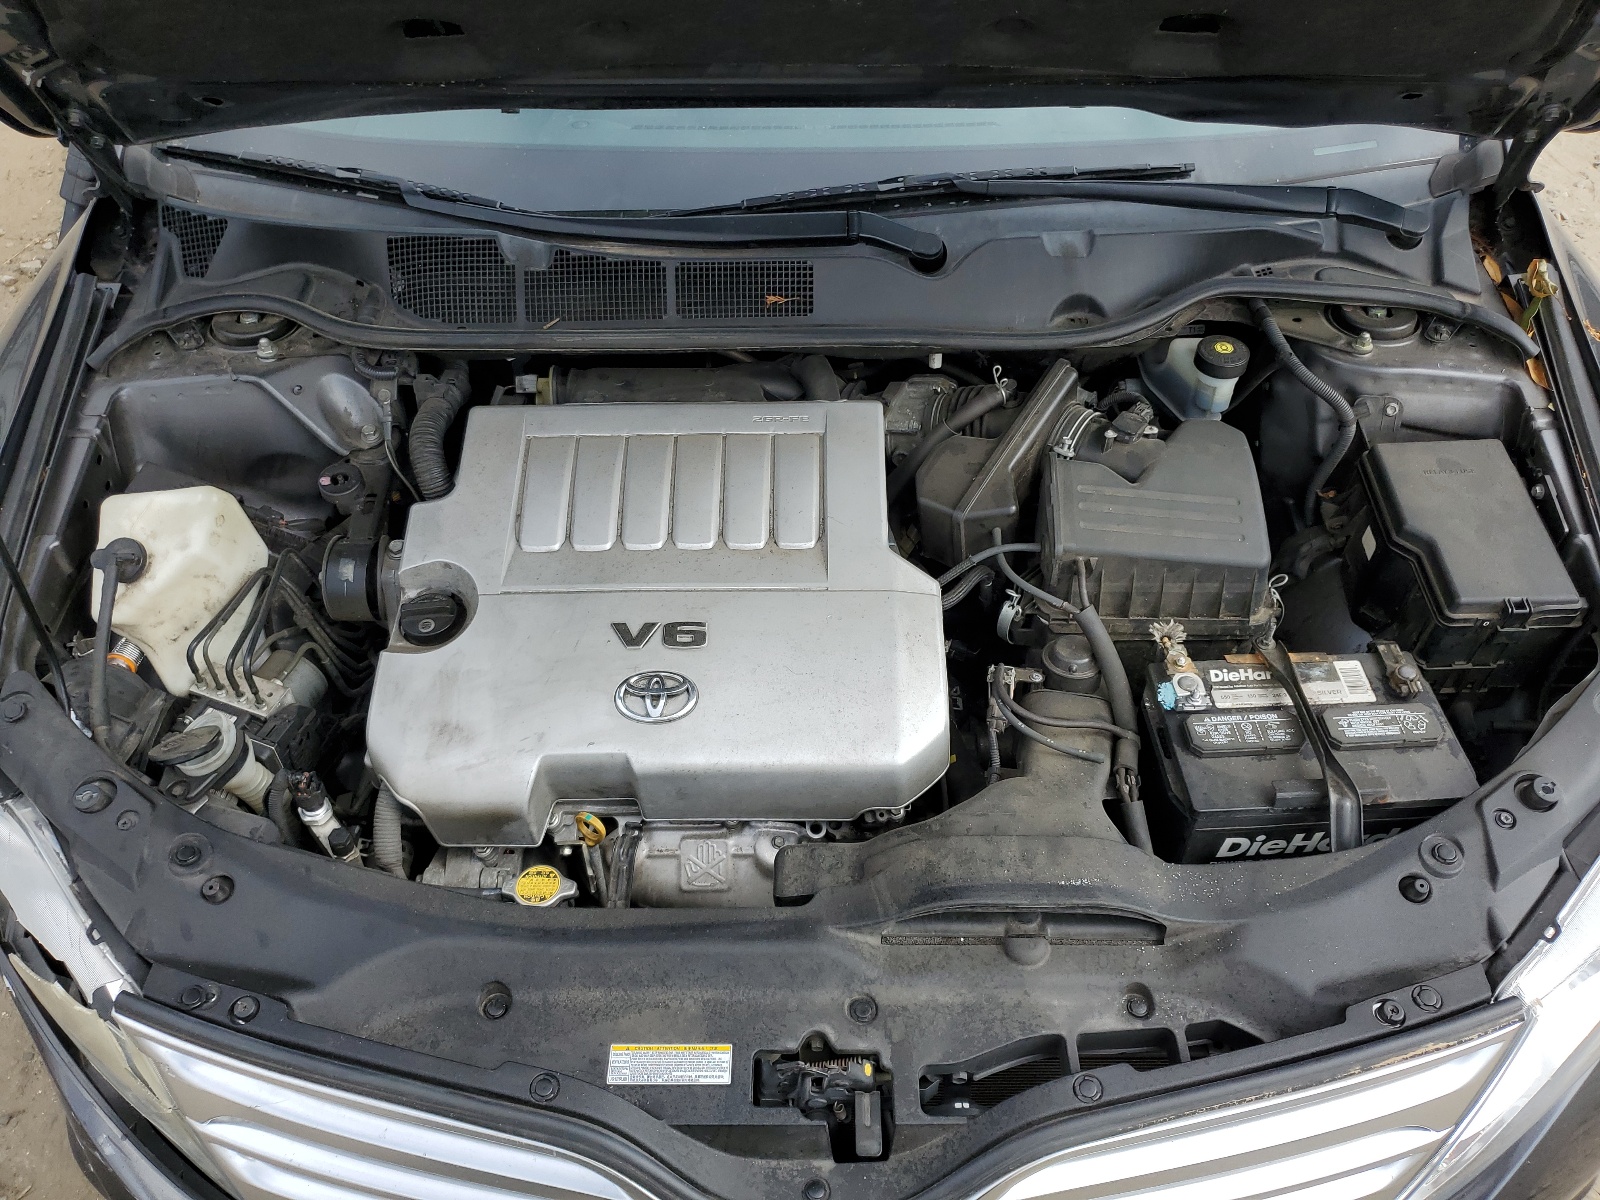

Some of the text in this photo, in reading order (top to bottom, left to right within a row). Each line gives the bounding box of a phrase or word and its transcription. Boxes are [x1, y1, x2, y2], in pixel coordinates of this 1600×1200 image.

[610, 621, 708, 650] V6
[1209, 668, 1273, 682] DieHar
[1210, 714, 1242, 722] DANGER
